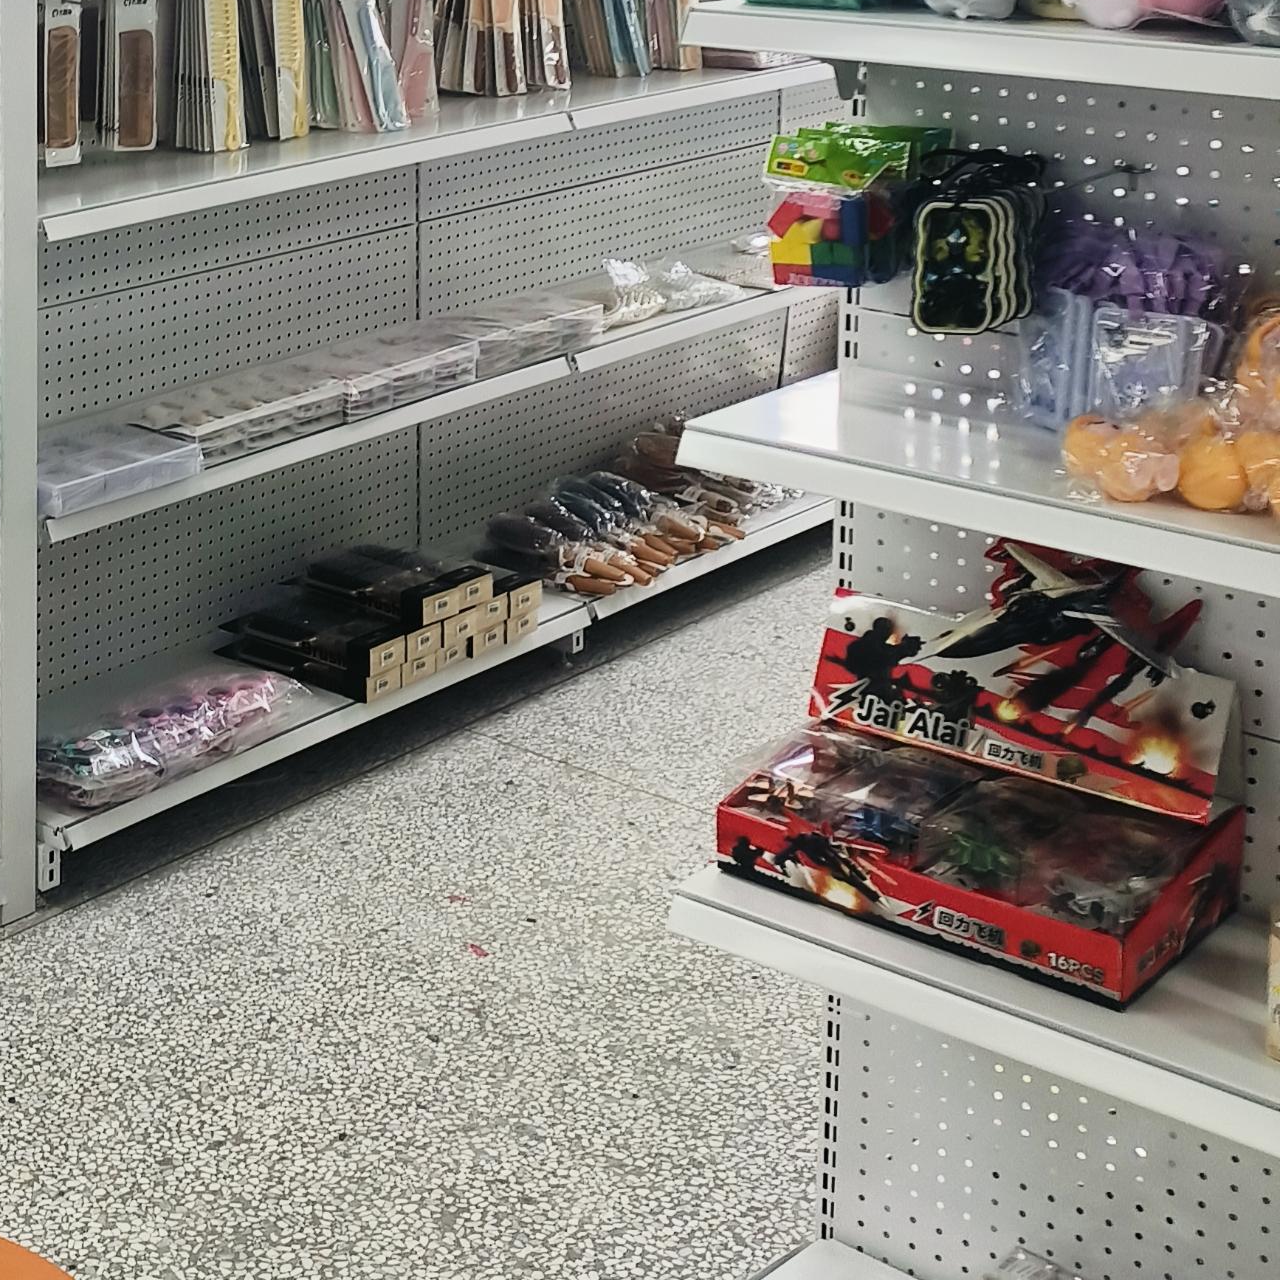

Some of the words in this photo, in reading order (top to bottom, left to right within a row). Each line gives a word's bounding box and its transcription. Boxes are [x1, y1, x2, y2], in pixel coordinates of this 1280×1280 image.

[988, 742, 1043, 770] 回力飞机
[1047, 951, 1106, 984] 16PCS
